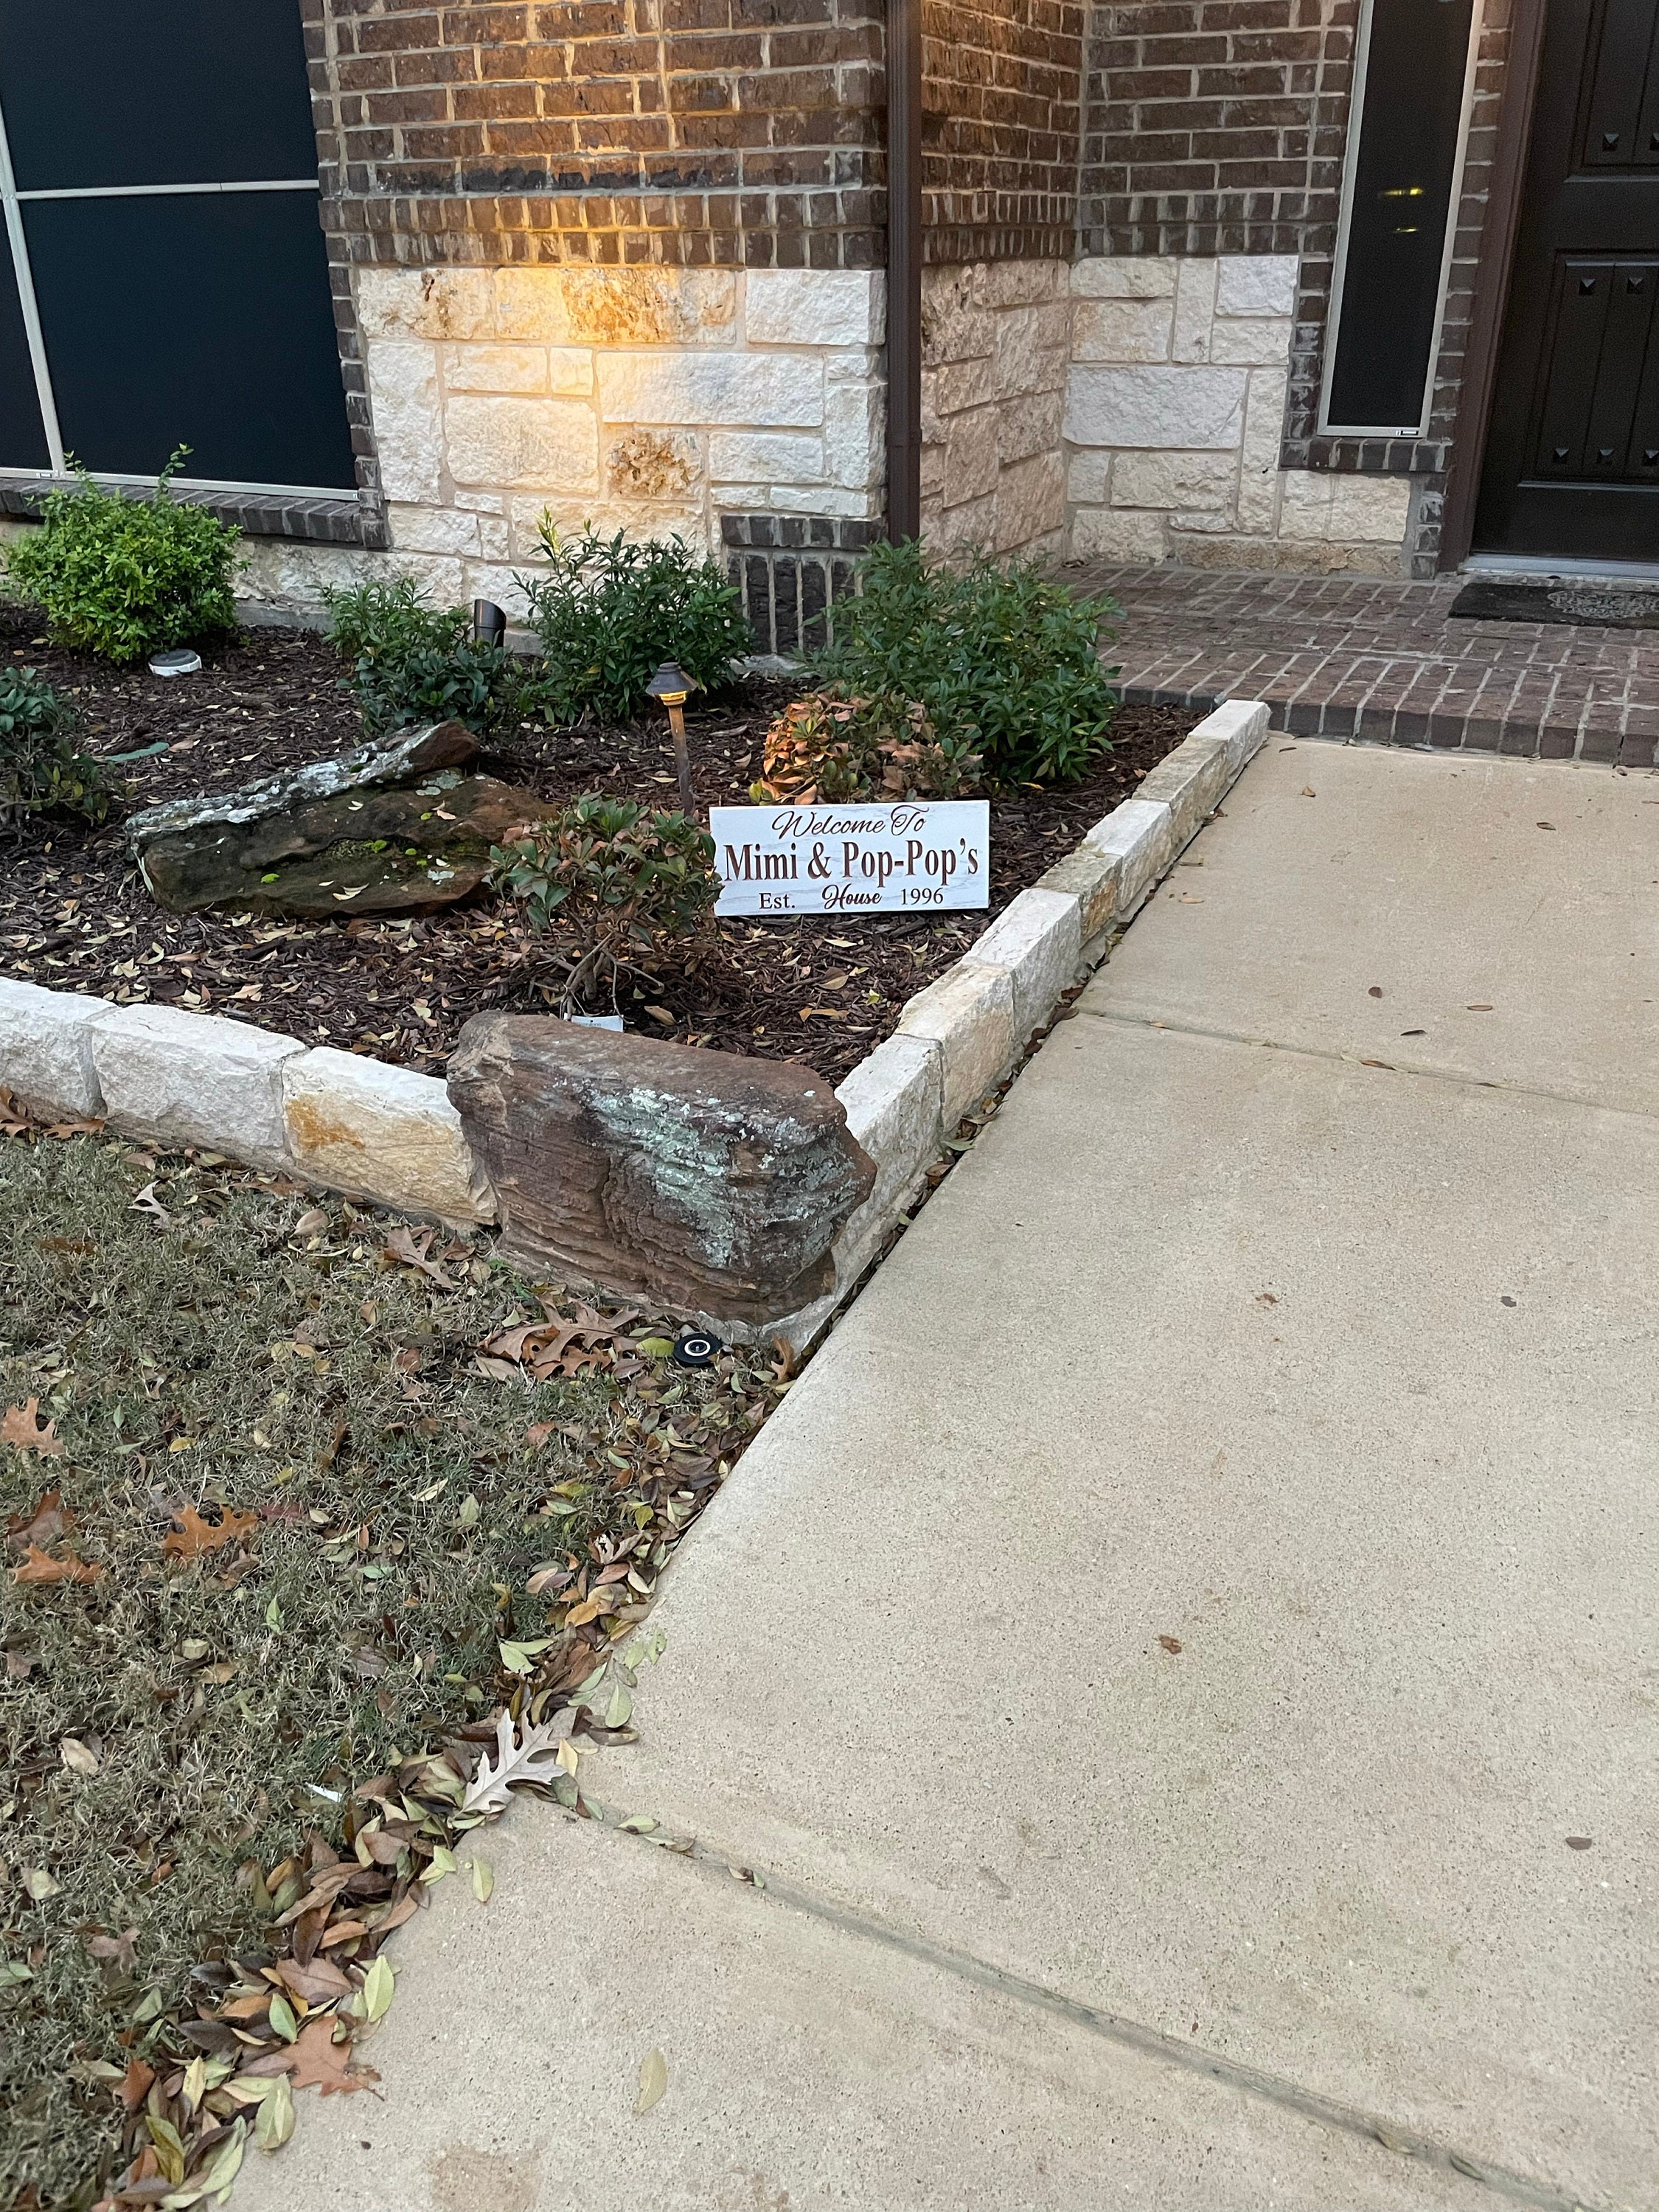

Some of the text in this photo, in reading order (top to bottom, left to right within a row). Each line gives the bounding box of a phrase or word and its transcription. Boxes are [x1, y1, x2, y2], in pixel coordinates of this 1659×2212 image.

[772, 805, 929, 839] Welcome To
[724, 838, 978, 887] Mimi & Pop-Pop's
[759, 884, 944, 910] Est. House 1996
